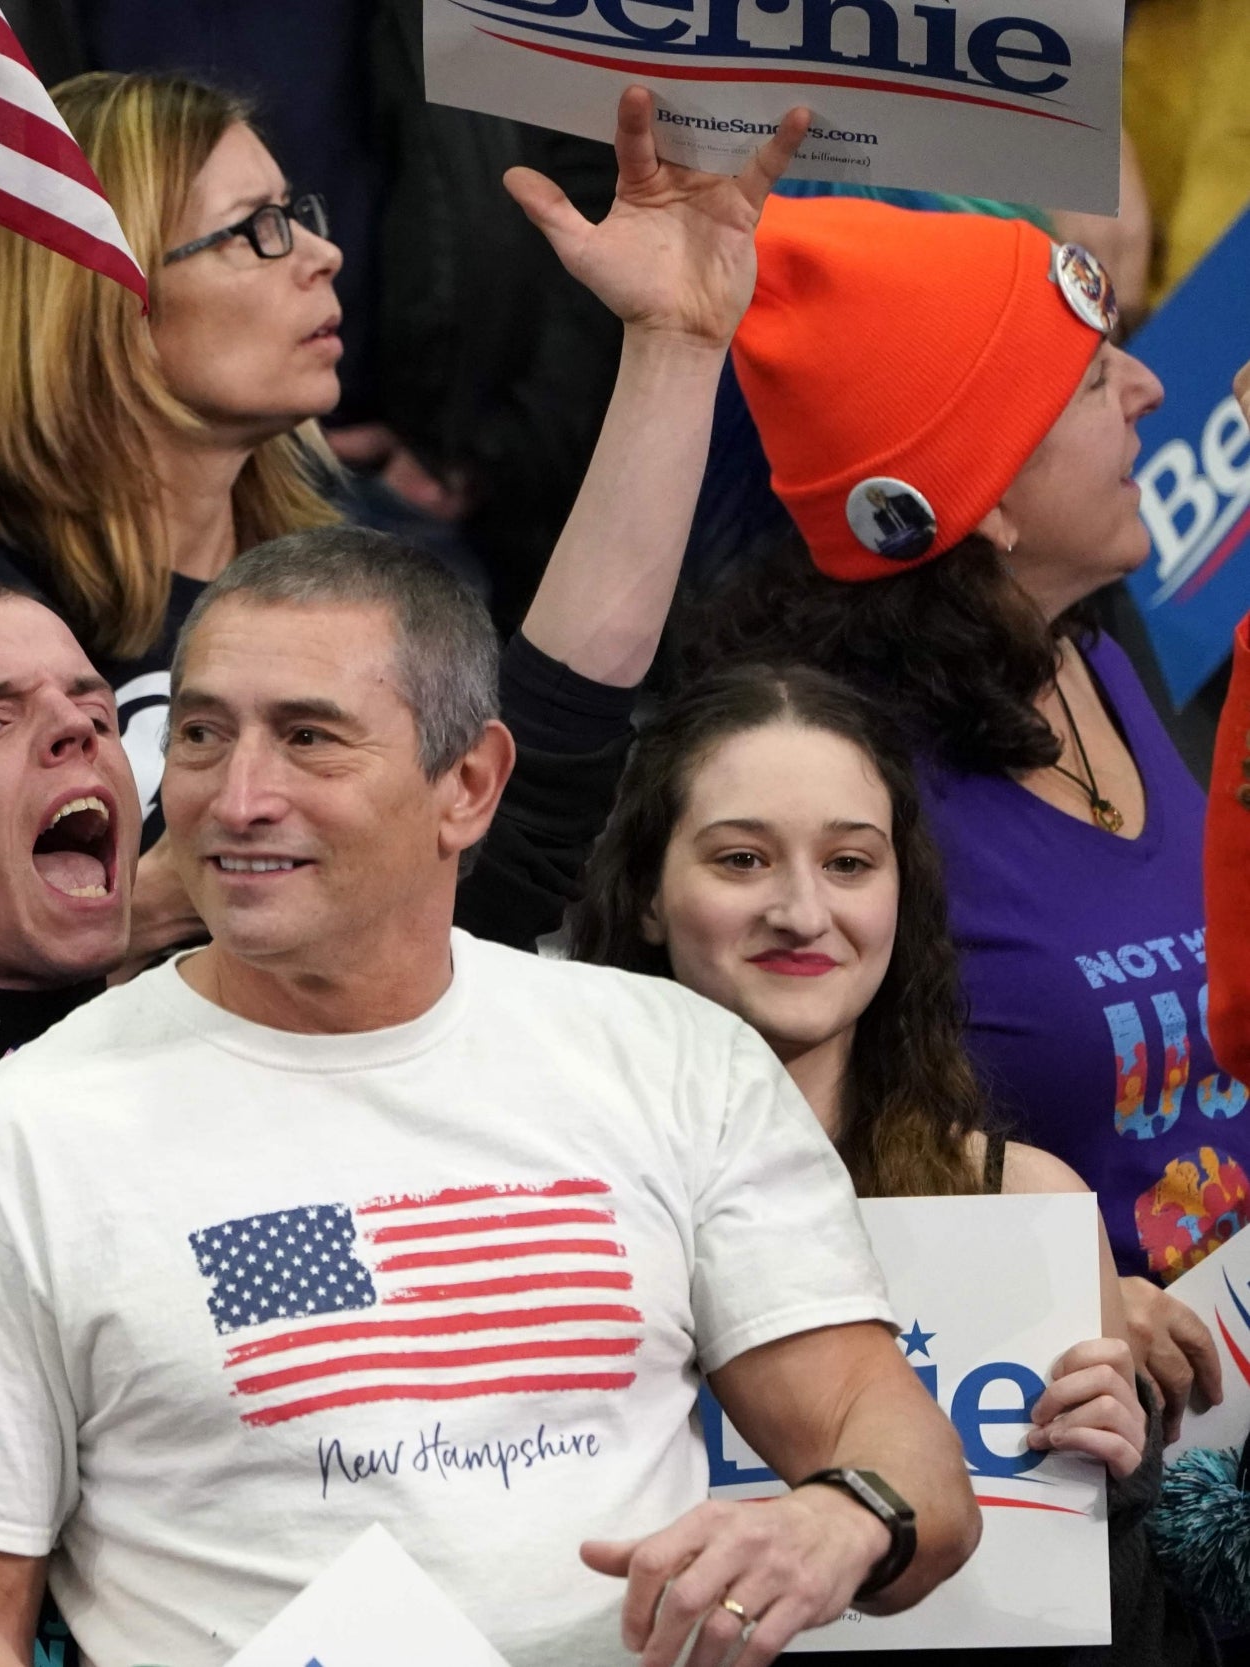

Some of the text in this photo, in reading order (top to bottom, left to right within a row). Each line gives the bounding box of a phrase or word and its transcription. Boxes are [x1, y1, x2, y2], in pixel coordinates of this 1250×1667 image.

[488, 0, 1072, 95] ernie
[656, 108, 879, 146] BernieSanrs.com
[793, 150, 808, 161] he
[1074, 936, 1182, 989] NOT
[318, 1421, 600, 1500] New Hampshire
